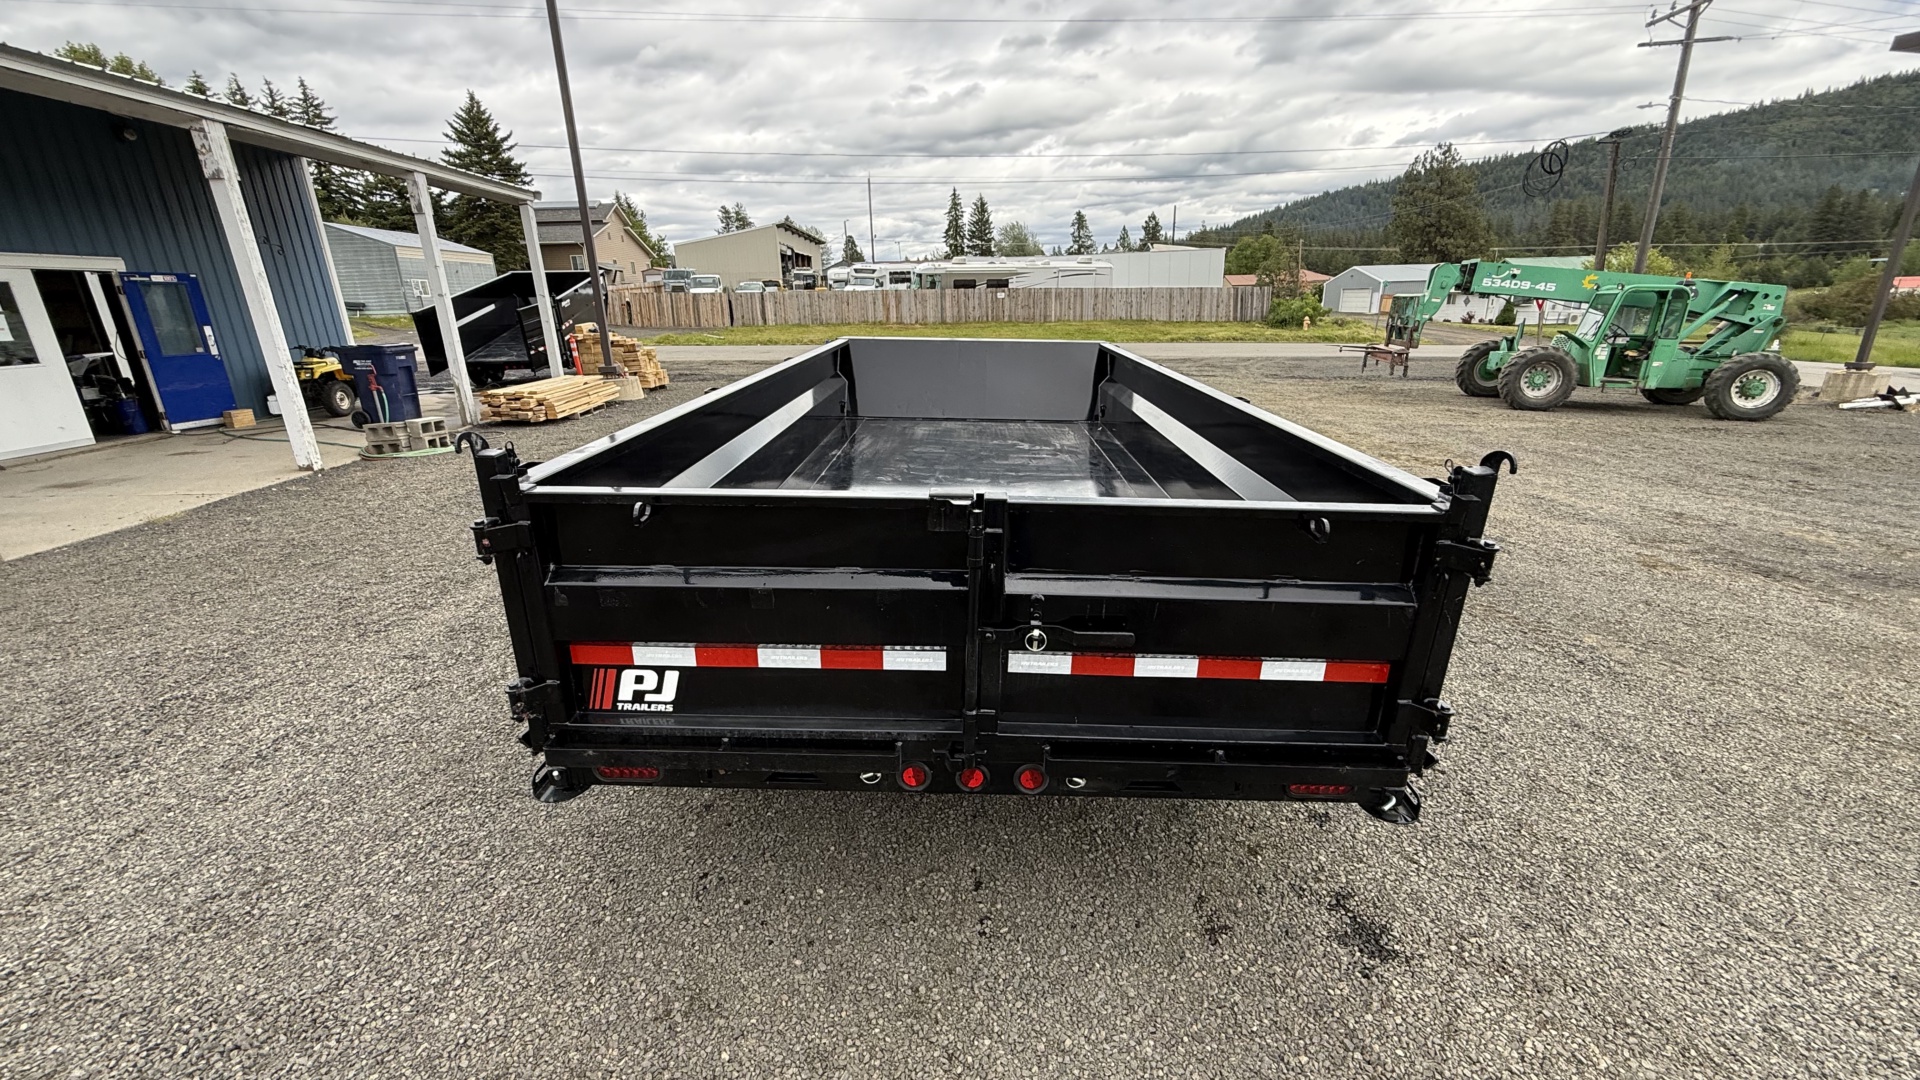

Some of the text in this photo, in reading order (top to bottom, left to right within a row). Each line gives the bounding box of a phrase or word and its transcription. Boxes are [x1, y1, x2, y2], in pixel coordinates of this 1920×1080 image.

[1482, 278, 1556, 291] 534D9-45
[618, 669, 680, 702] PJ
[617, 703, 673, 711] TRAILERS
